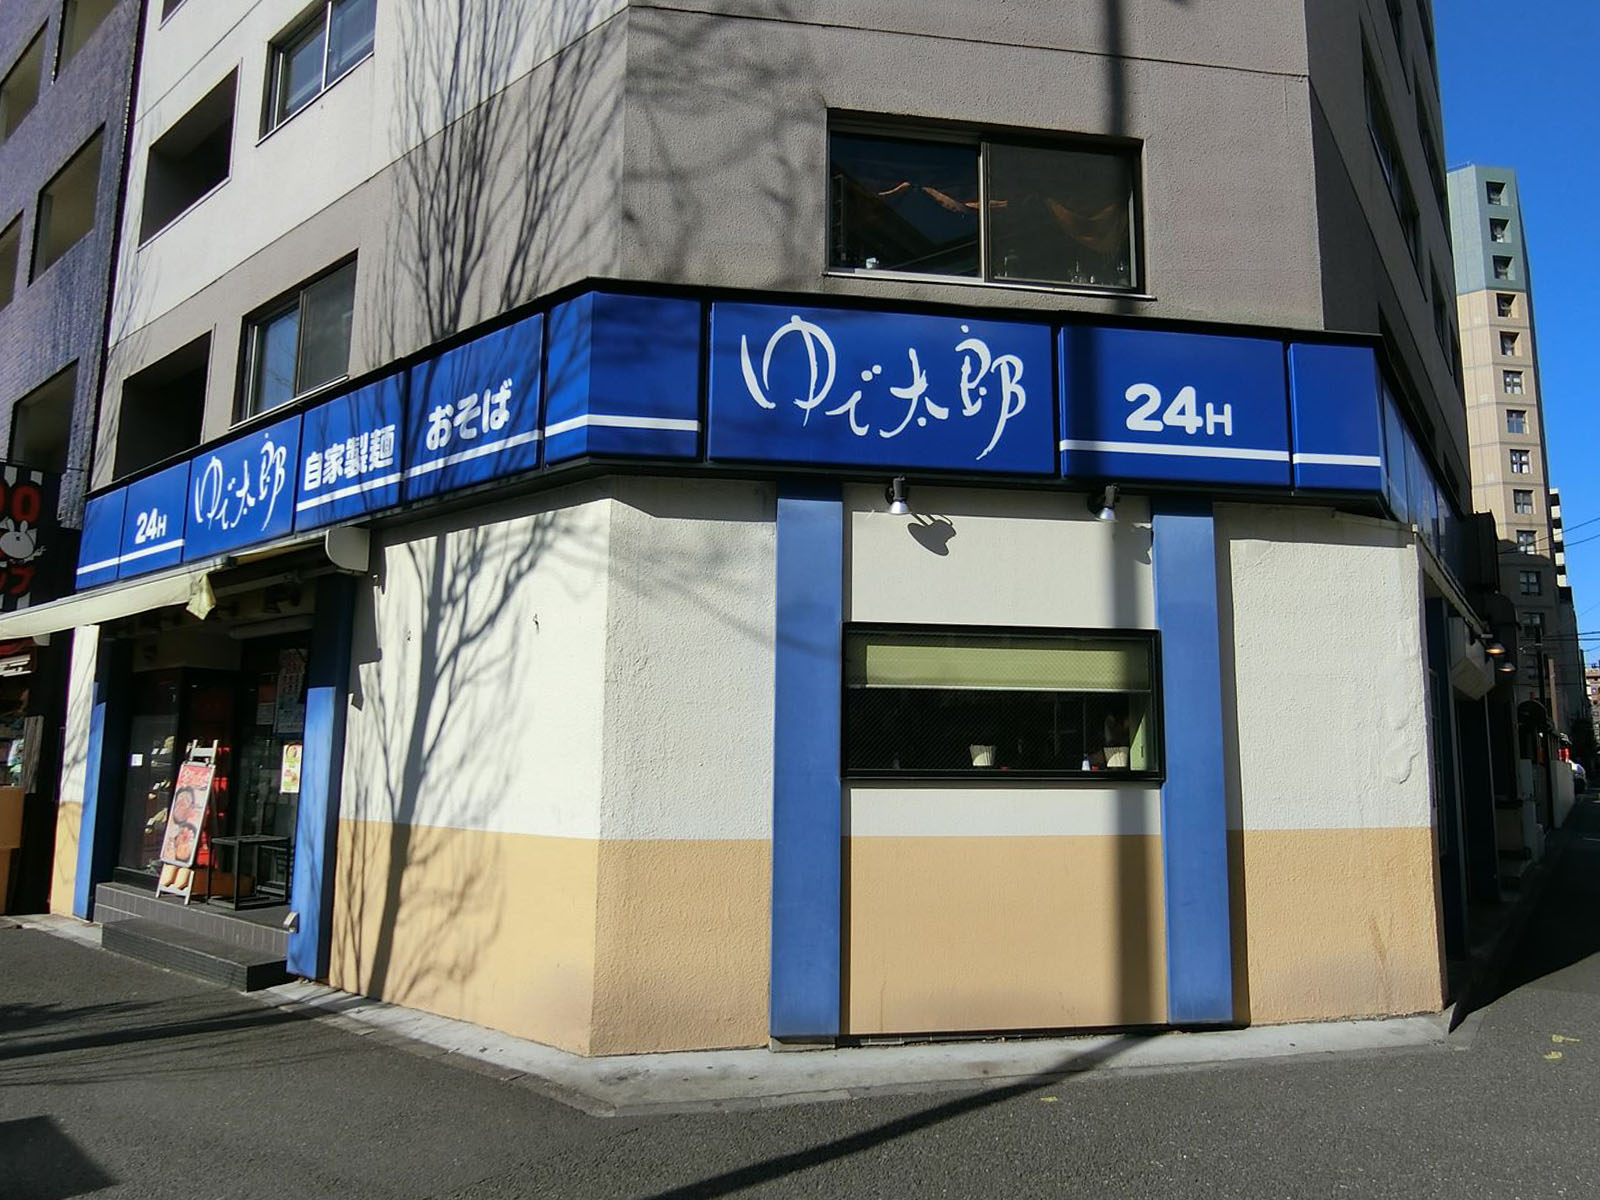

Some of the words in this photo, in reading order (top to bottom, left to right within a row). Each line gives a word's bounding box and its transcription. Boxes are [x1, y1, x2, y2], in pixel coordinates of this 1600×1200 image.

[426, 379, 513, 451] おそば
[1125, 383, 1234, 437] 24H
[304, 426, 396, 493] 自家製麺
[135, 508, 167, 545] 24H
